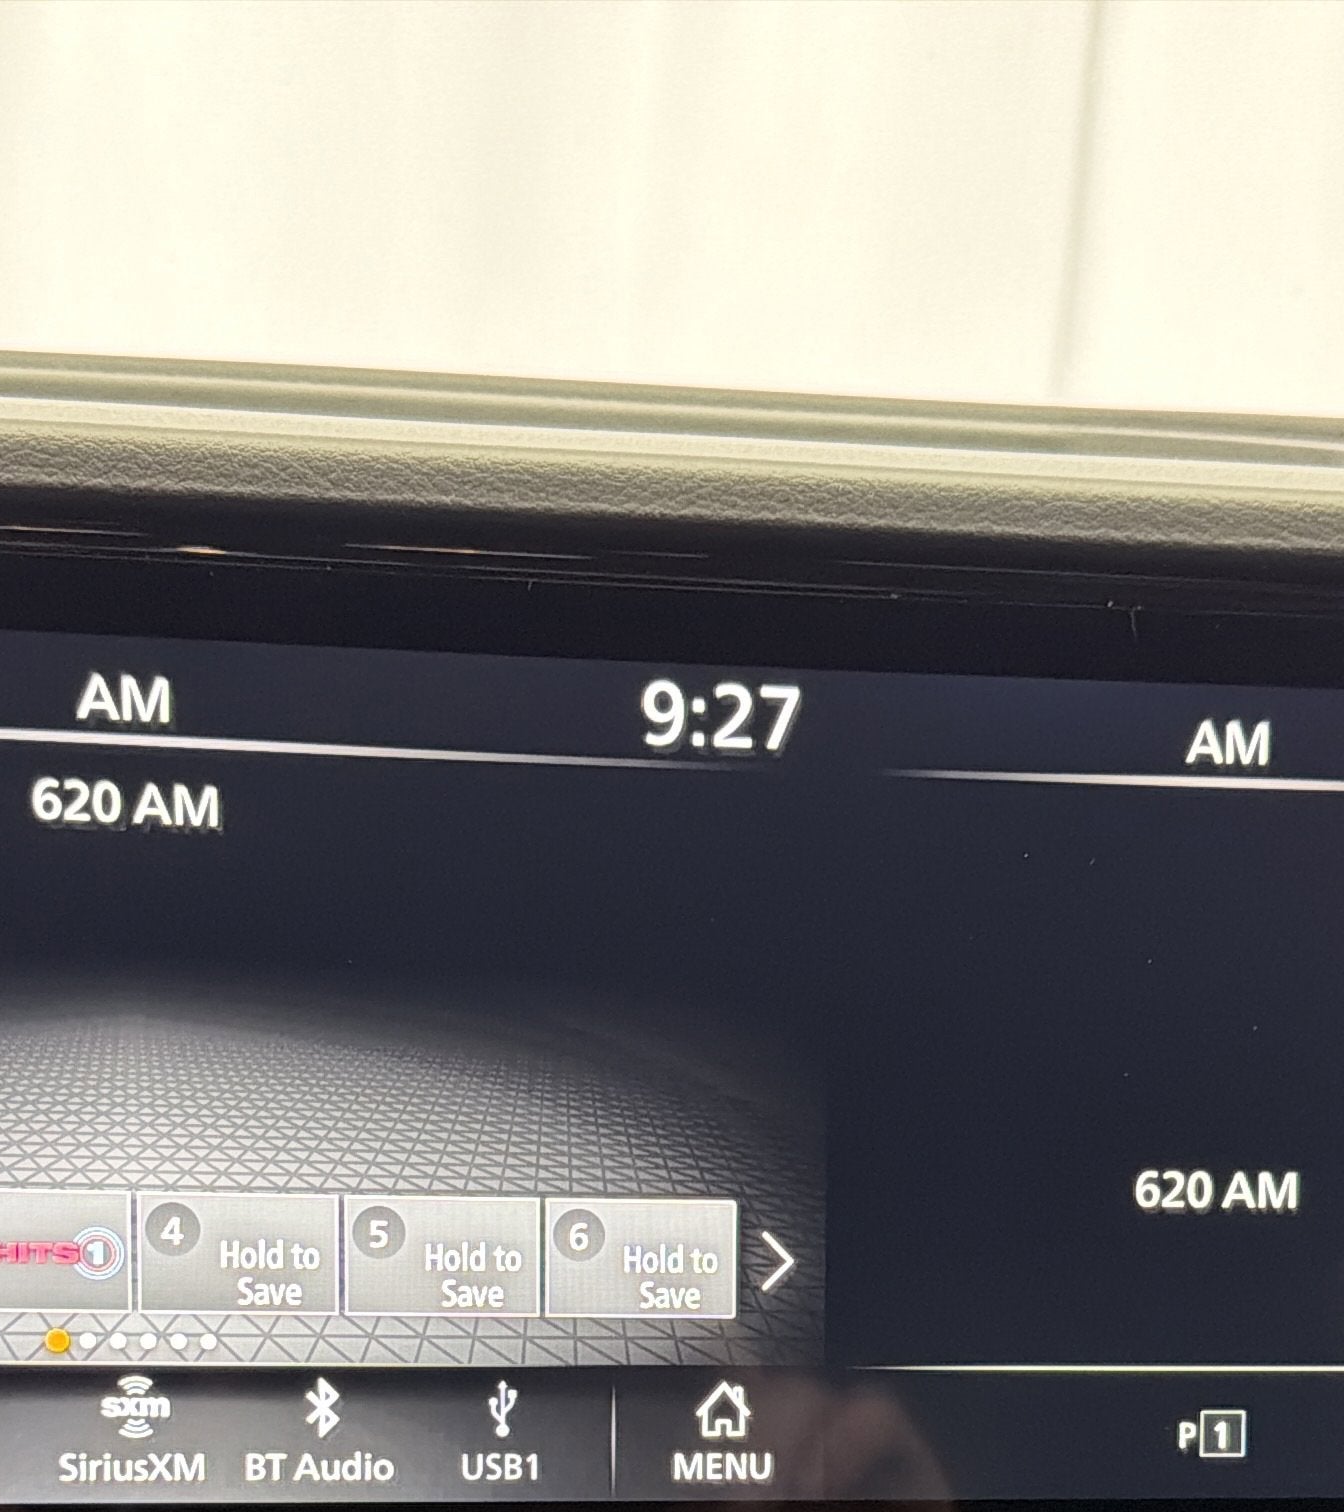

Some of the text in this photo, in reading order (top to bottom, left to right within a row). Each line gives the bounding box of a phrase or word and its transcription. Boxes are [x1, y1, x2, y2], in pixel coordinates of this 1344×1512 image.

[77, 672, 172, 724] AM
[642, 680, 801, 752] 9:27
[1186, 720, 1271, 766] AM
[31, 777, 221, 829] 620 AM
[1135, 1171, 1298, 1210] 620 AM
[161, 1218, 184, 1245] 4
[369, 1220, 388, 1248] 5
[568, 1223, 589, 1250] 6
[219, 1240, 320, 1270] Hold to
[424, 1241, 522, 1273] Hold to
[623, 1244, 718, 1274] Hold to
[237, 1277, 303, 1306] Save
[441, 1281, 504, 1308] Save
[639, 1282, 701, 1310] Save
[1178, 1422, 1228, 1450] P 1
[59, 1453, 206, 1482] SiriusXM
[245, 1453, 395, 1482] BT Audio
[461, 1453, 540, 1481] USB1
[672, 1453, 773, 1482] MENU
